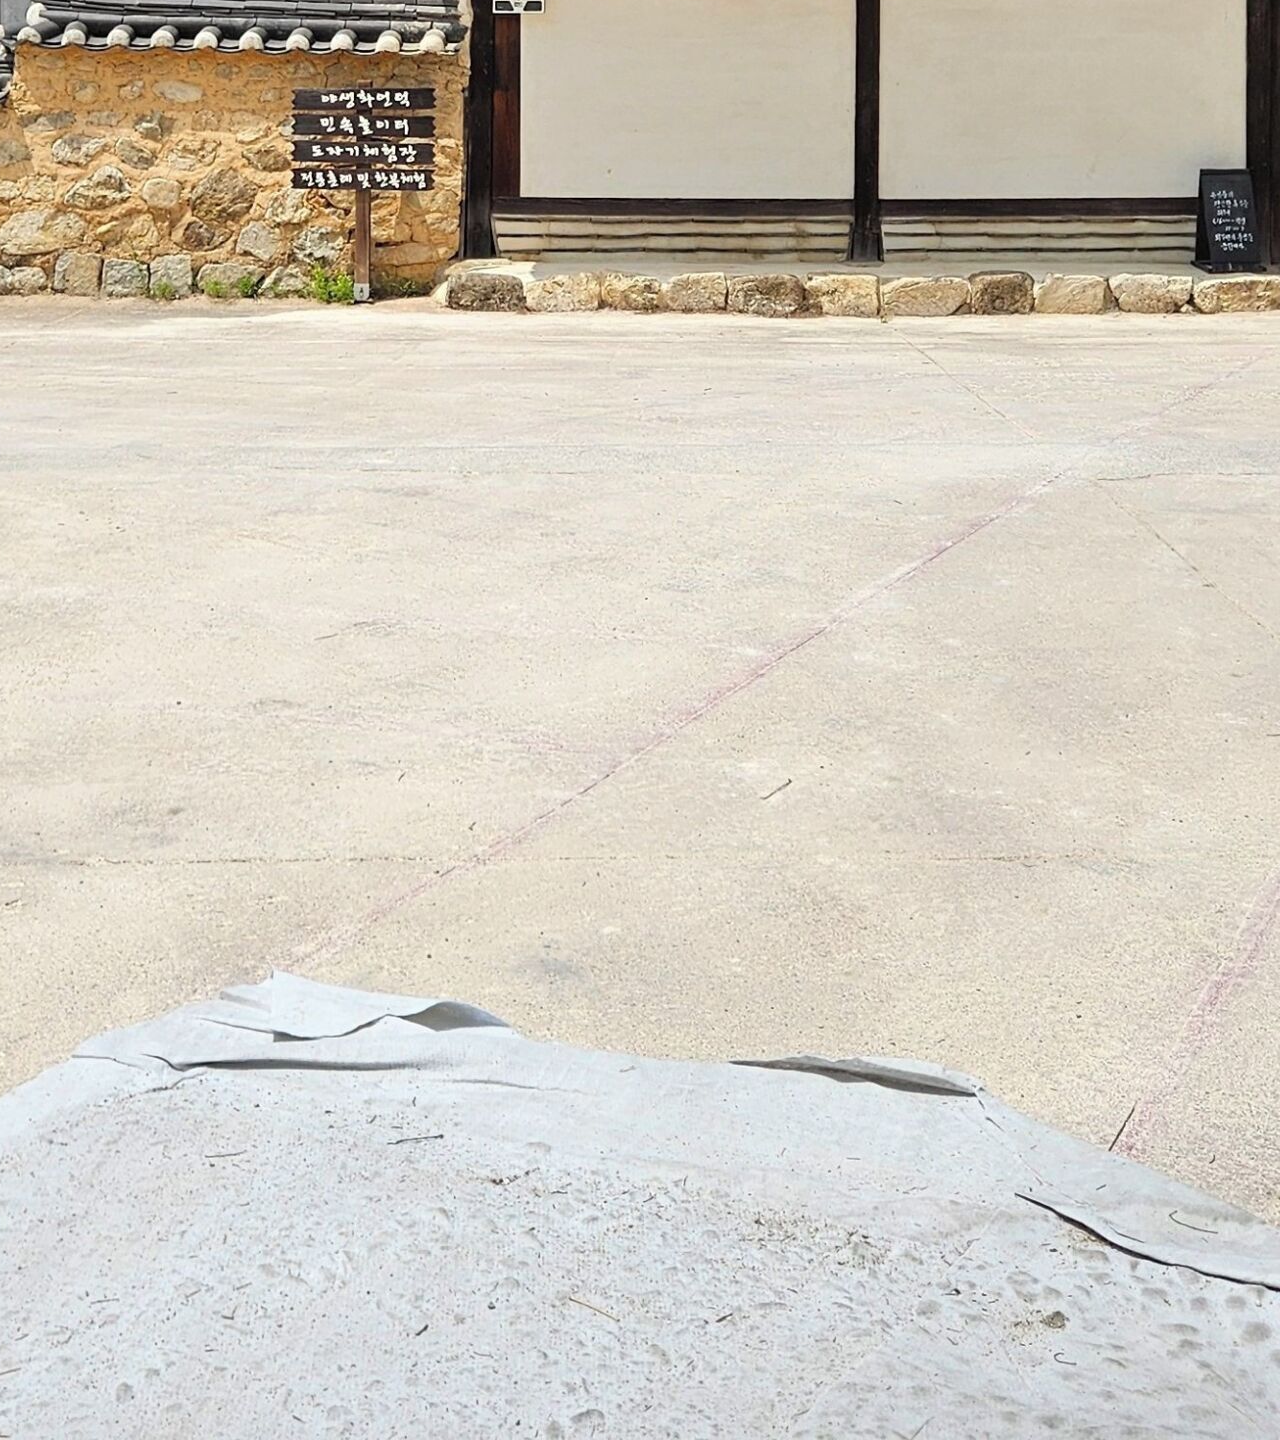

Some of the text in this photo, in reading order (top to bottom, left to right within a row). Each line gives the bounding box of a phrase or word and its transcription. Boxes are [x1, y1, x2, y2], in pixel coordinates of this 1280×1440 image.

[320, 90, 411, 109] 야생화언덕
[319, 115, 410, 136] 민속놀이터
[311, 143, 418, 163] 도자기체험장
[357, 171, 372, 189] 및
